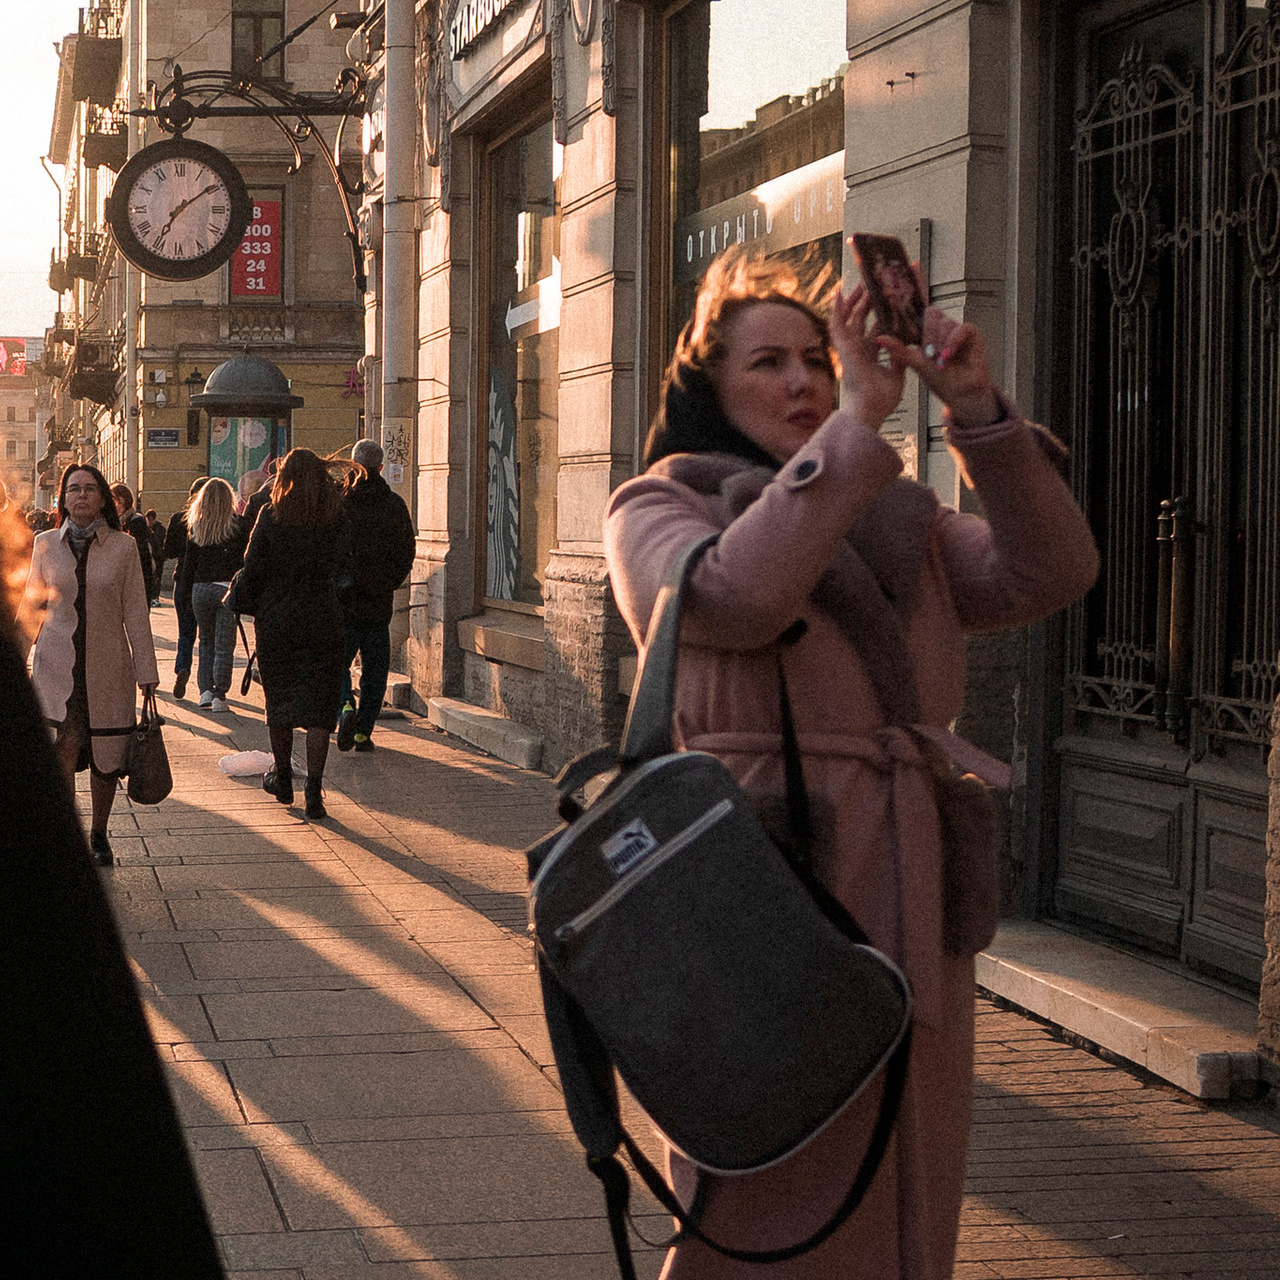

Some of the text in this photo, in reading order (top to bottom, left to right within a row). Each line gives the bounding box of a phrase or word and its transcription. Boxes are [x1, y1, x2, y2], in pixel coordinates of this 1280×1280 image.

[793, 178, 834, 224] OPE
[241, 242, 272, 254] 333
[246, 259, 266, 272] 24
[246, 277, 266, 290] 31
